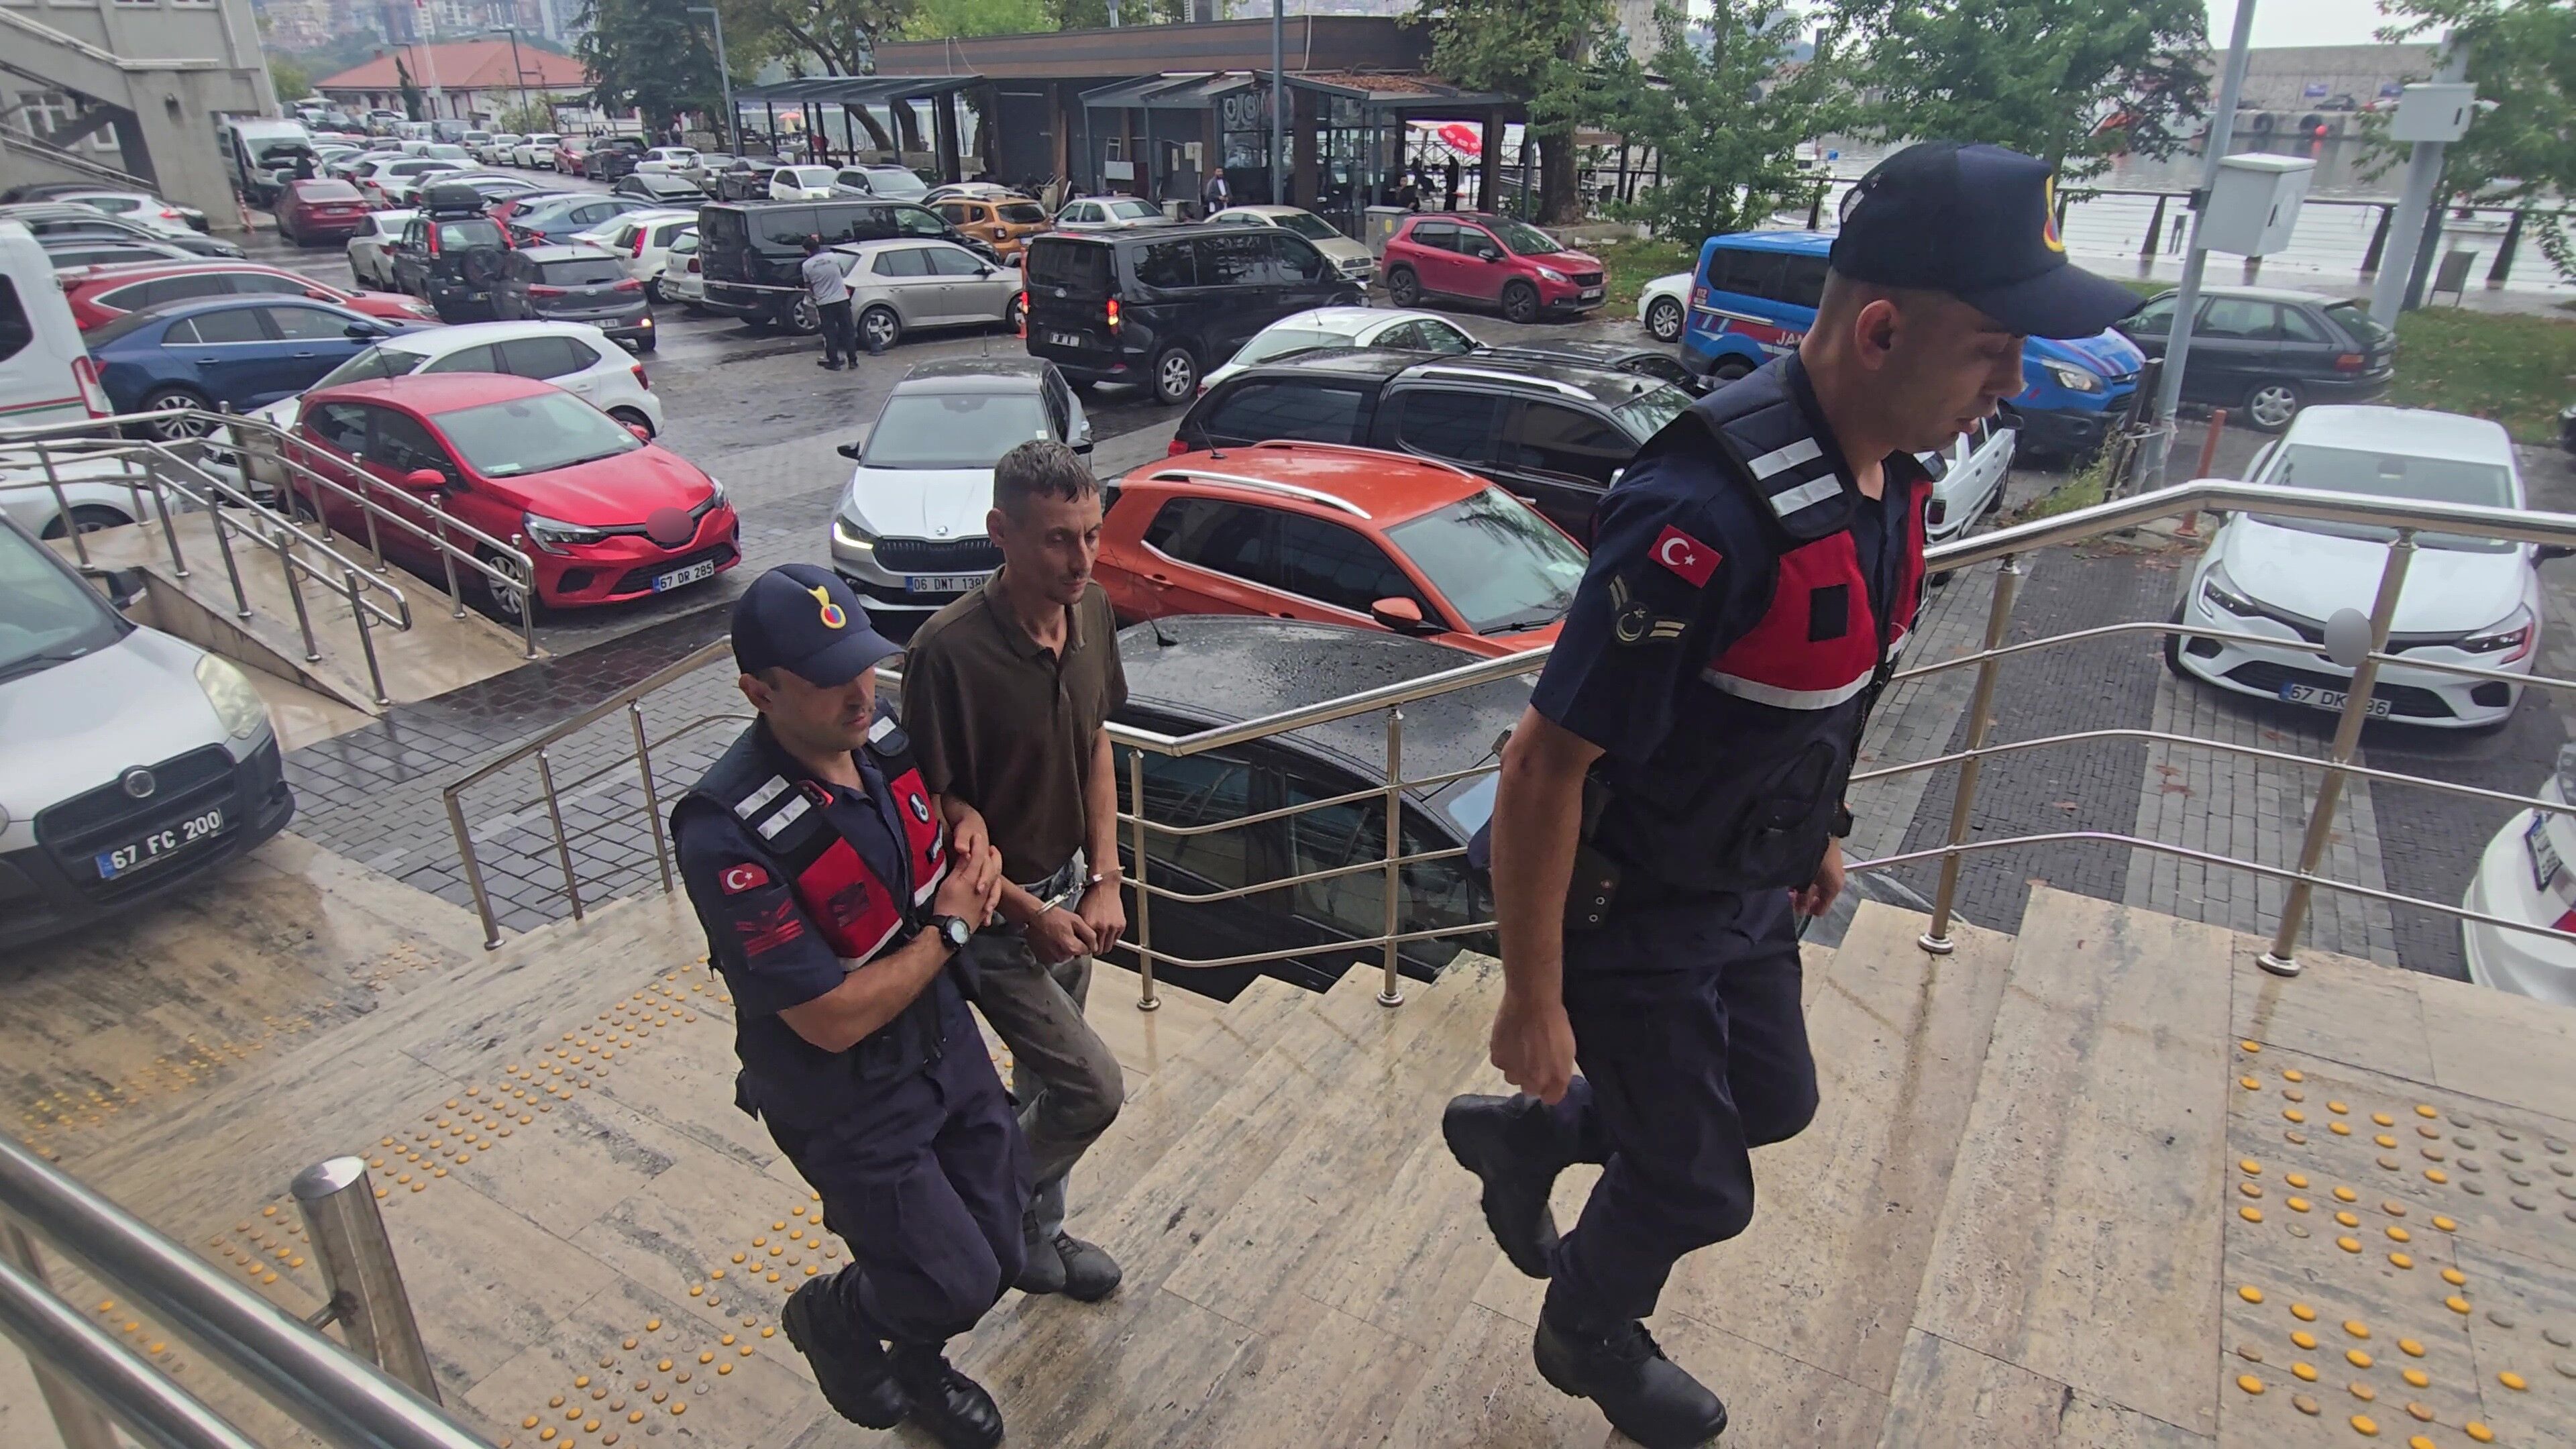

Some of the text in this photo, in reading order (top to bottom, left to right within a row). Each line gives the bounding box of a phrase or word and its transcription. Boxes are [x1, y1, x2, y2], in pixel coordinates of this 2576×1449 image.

[660, 564, 712, 589] 67 DR 285
[914, 579, 927, 590] 06
[934, 578, 953, 590] DNT
[2291, 686, 2314, 700] 67
[2320, 692, 2348, 706] DK
[111, 845, 136, 869] 67
[147, 830, 176, 855] FC
[182, 811, 221, 840] 200
